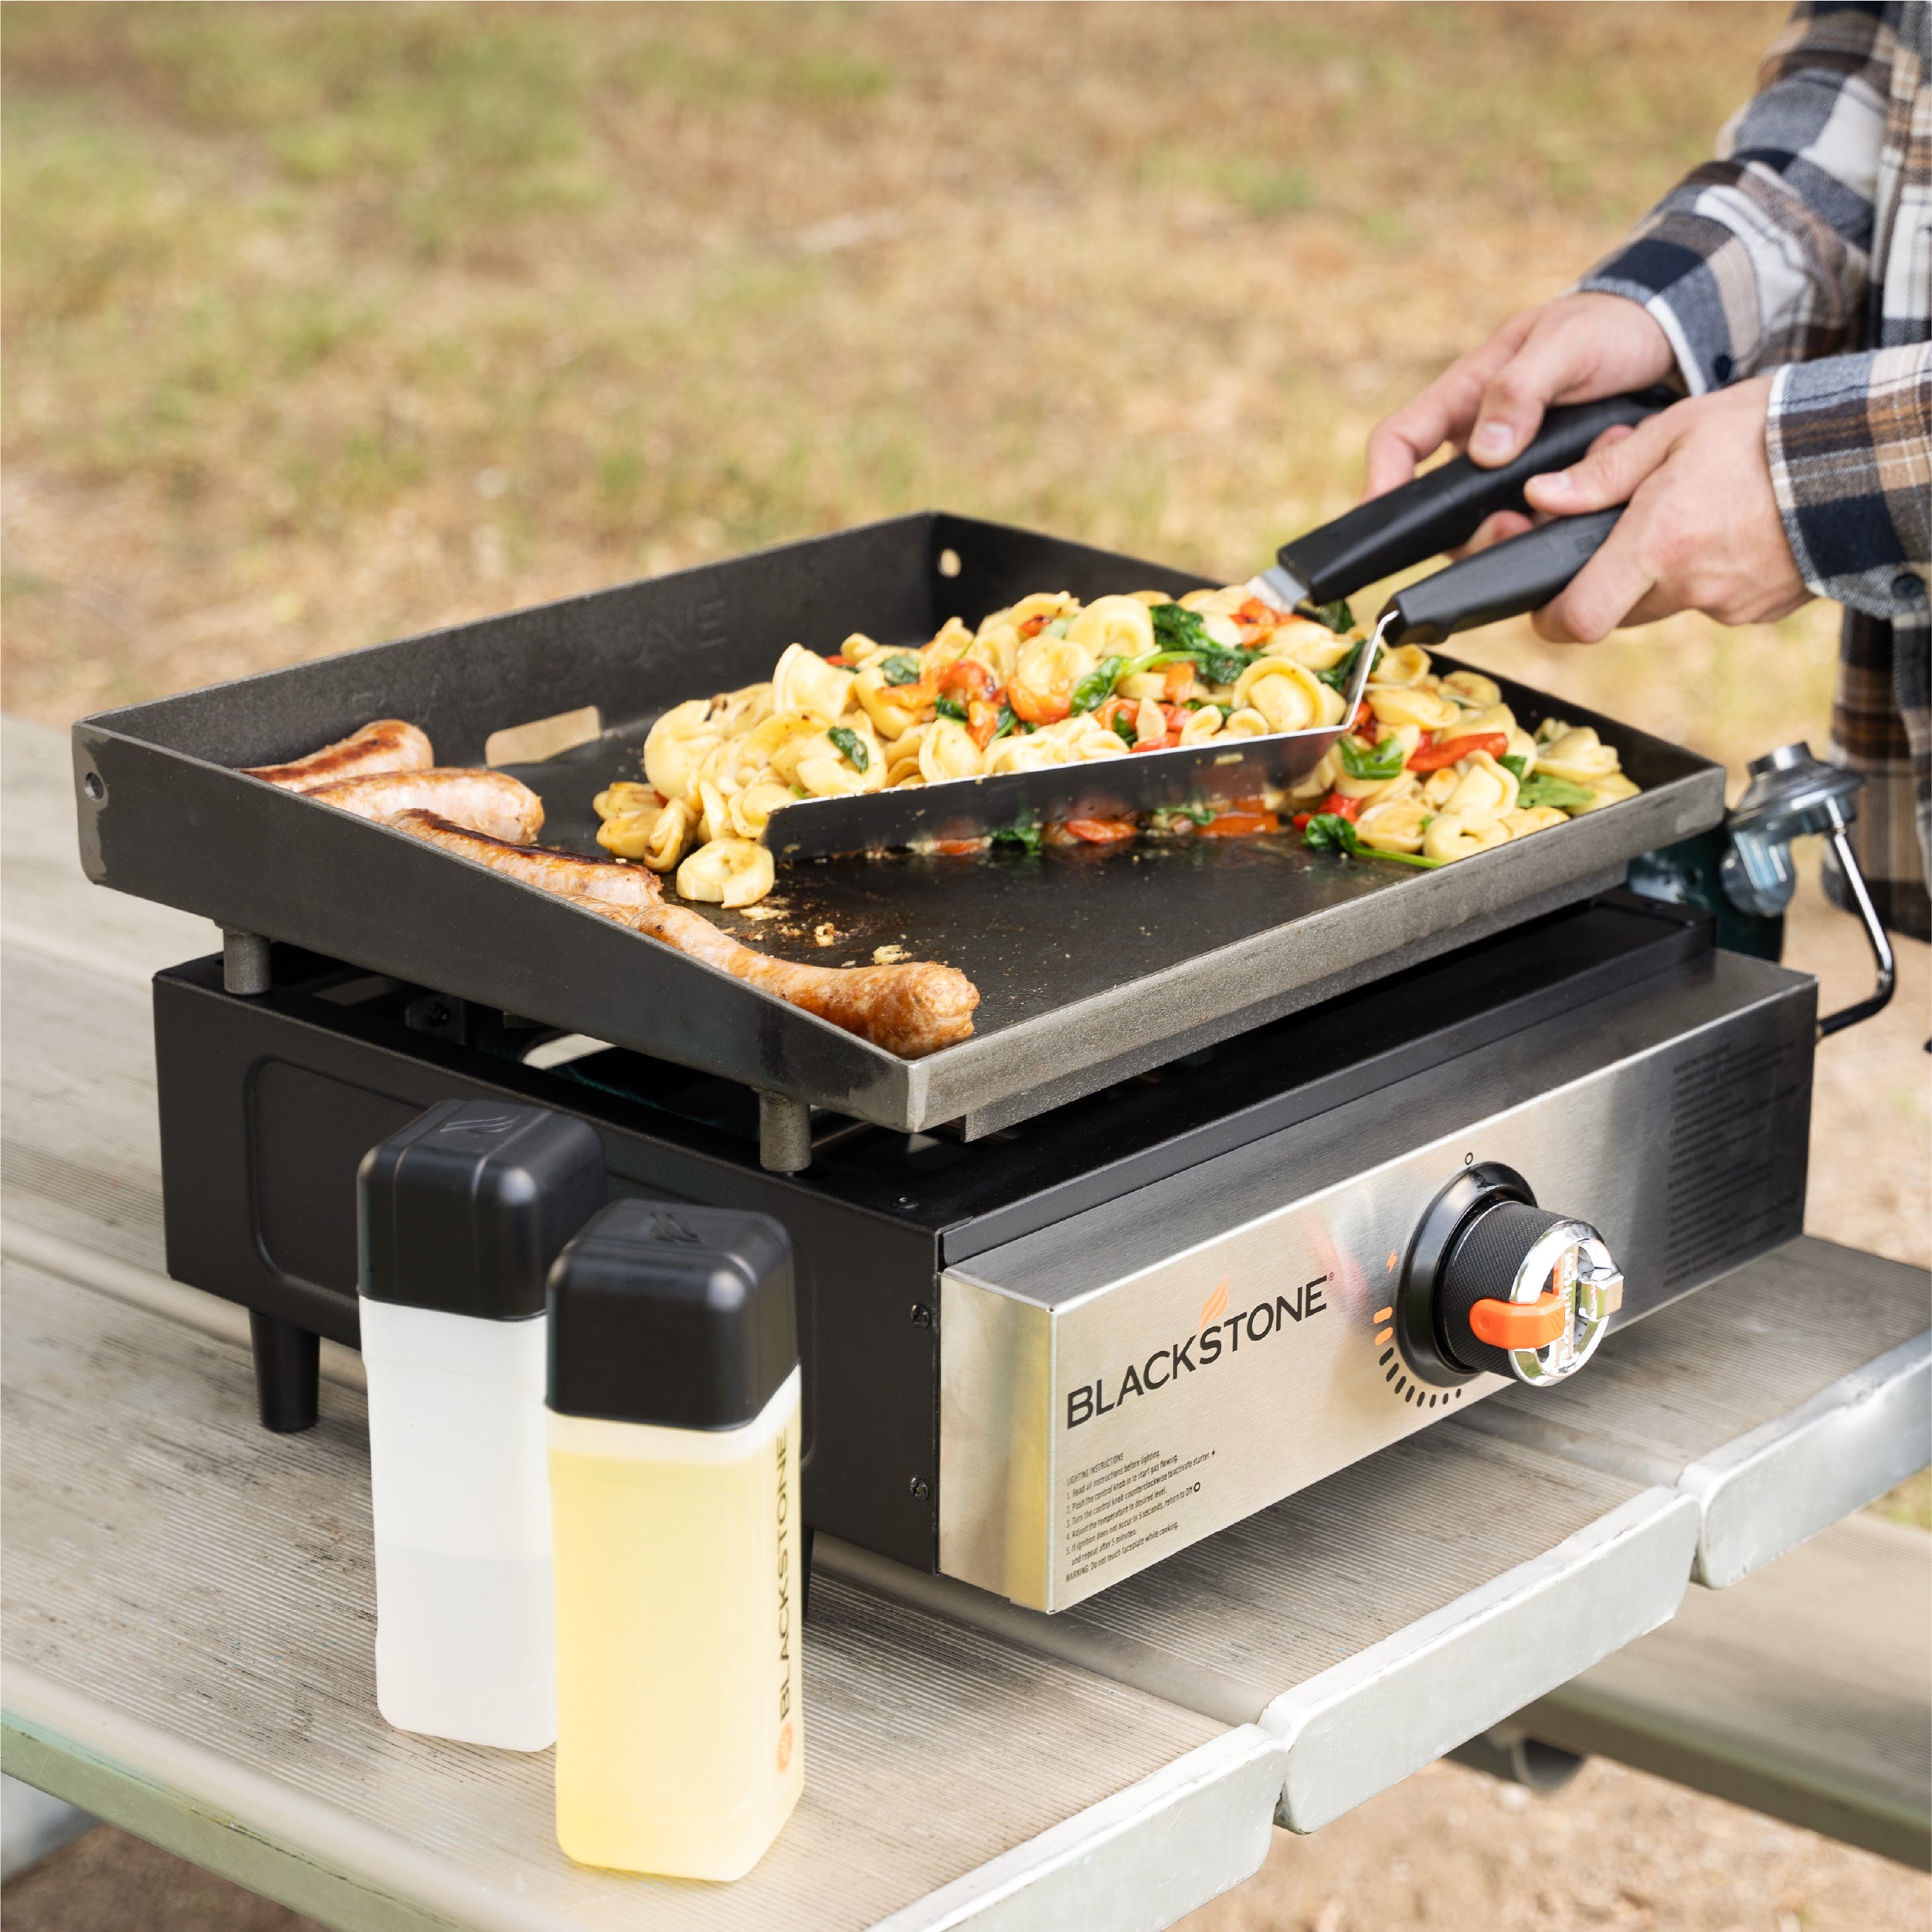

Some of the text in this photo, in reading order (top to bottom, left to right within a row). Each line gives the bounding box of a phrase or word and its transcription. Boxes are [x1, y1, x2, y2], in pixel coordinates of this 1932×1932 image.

[1067, 1452, 1123, 1486] LIGHTING INSTRUCTIONS
[1072, 1485, 1085, 1496] Read
[1093, 1468, 1122, 1486] instructions
[1123, 1459, 1139, 1472] before
[1072, 1499, 1084, 1510] Push
[1095, 1487, 1112, 1499] control
[1113, 1480, 1125, 1490] knob
[1138, 1468, 1149, 1479] start
[1072, 1514, 1082, 1523] Turn
[1093, 1502, 1111, 1513] control
[1112, 1495, 1123, 1504] knob
[1125, 1474, 1166, 1498] counterclockwise
[1173, 1462, 1191, 1475] activate
[1071, 1526, 1087, 1537] Adjust
[1098, 1507, 1128, 1525] temperature
[1135, 1494, 1153, 1506] desired
[1076, 1536, 1095, 1550] ignition
[1097, 1529, 1108, 1539] does
[1118, 1519, 1132, 1529] occur
[1164, 1495, 1179, 1506] return
[1066, 1565, 1088, 1581] WARNING:
[1107, 1550, 1120, 1560] touch
[1122, 1539, 1143, 1553] faceplate
[1145, 1532, 1157, 1542] while
[1082, 1548, 1097, 1562] repeat
[1098, 1542, 1110, 1552] after
[1115, 1530, 1136, 1543] minutes.
[777, 1428, 789, 1722] BLACKSTONE
